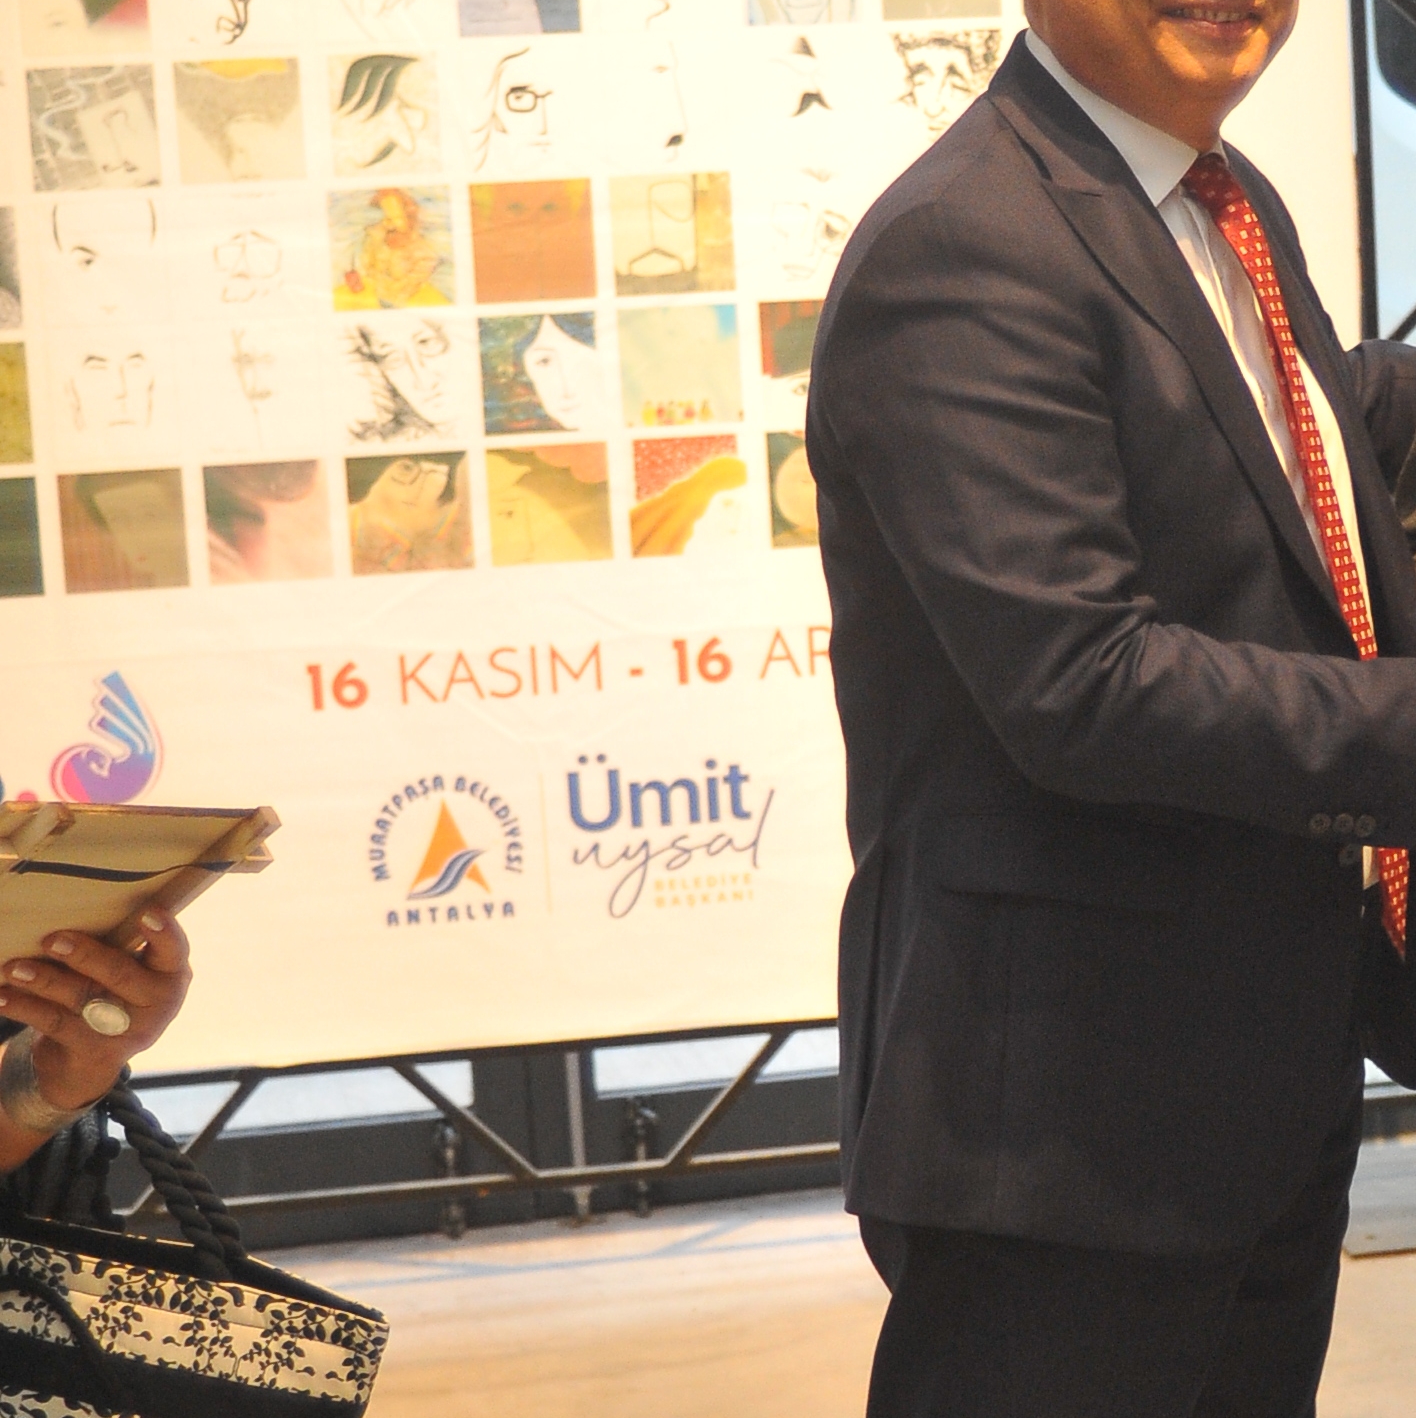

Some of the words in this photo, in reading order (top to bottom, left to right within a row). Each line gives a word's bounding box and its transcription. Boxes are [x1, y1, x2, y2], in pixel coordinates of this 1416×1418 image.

[306, 661, 369, 712] 16
[398, 641, 604, 705] KASIM
[672, 636, 733, 686] 16
[368, 774, 445, 882] MURATPAŞA
[567, 753, 753, 832] Ümit
[386, 900, 516, 928] ANTALYA
